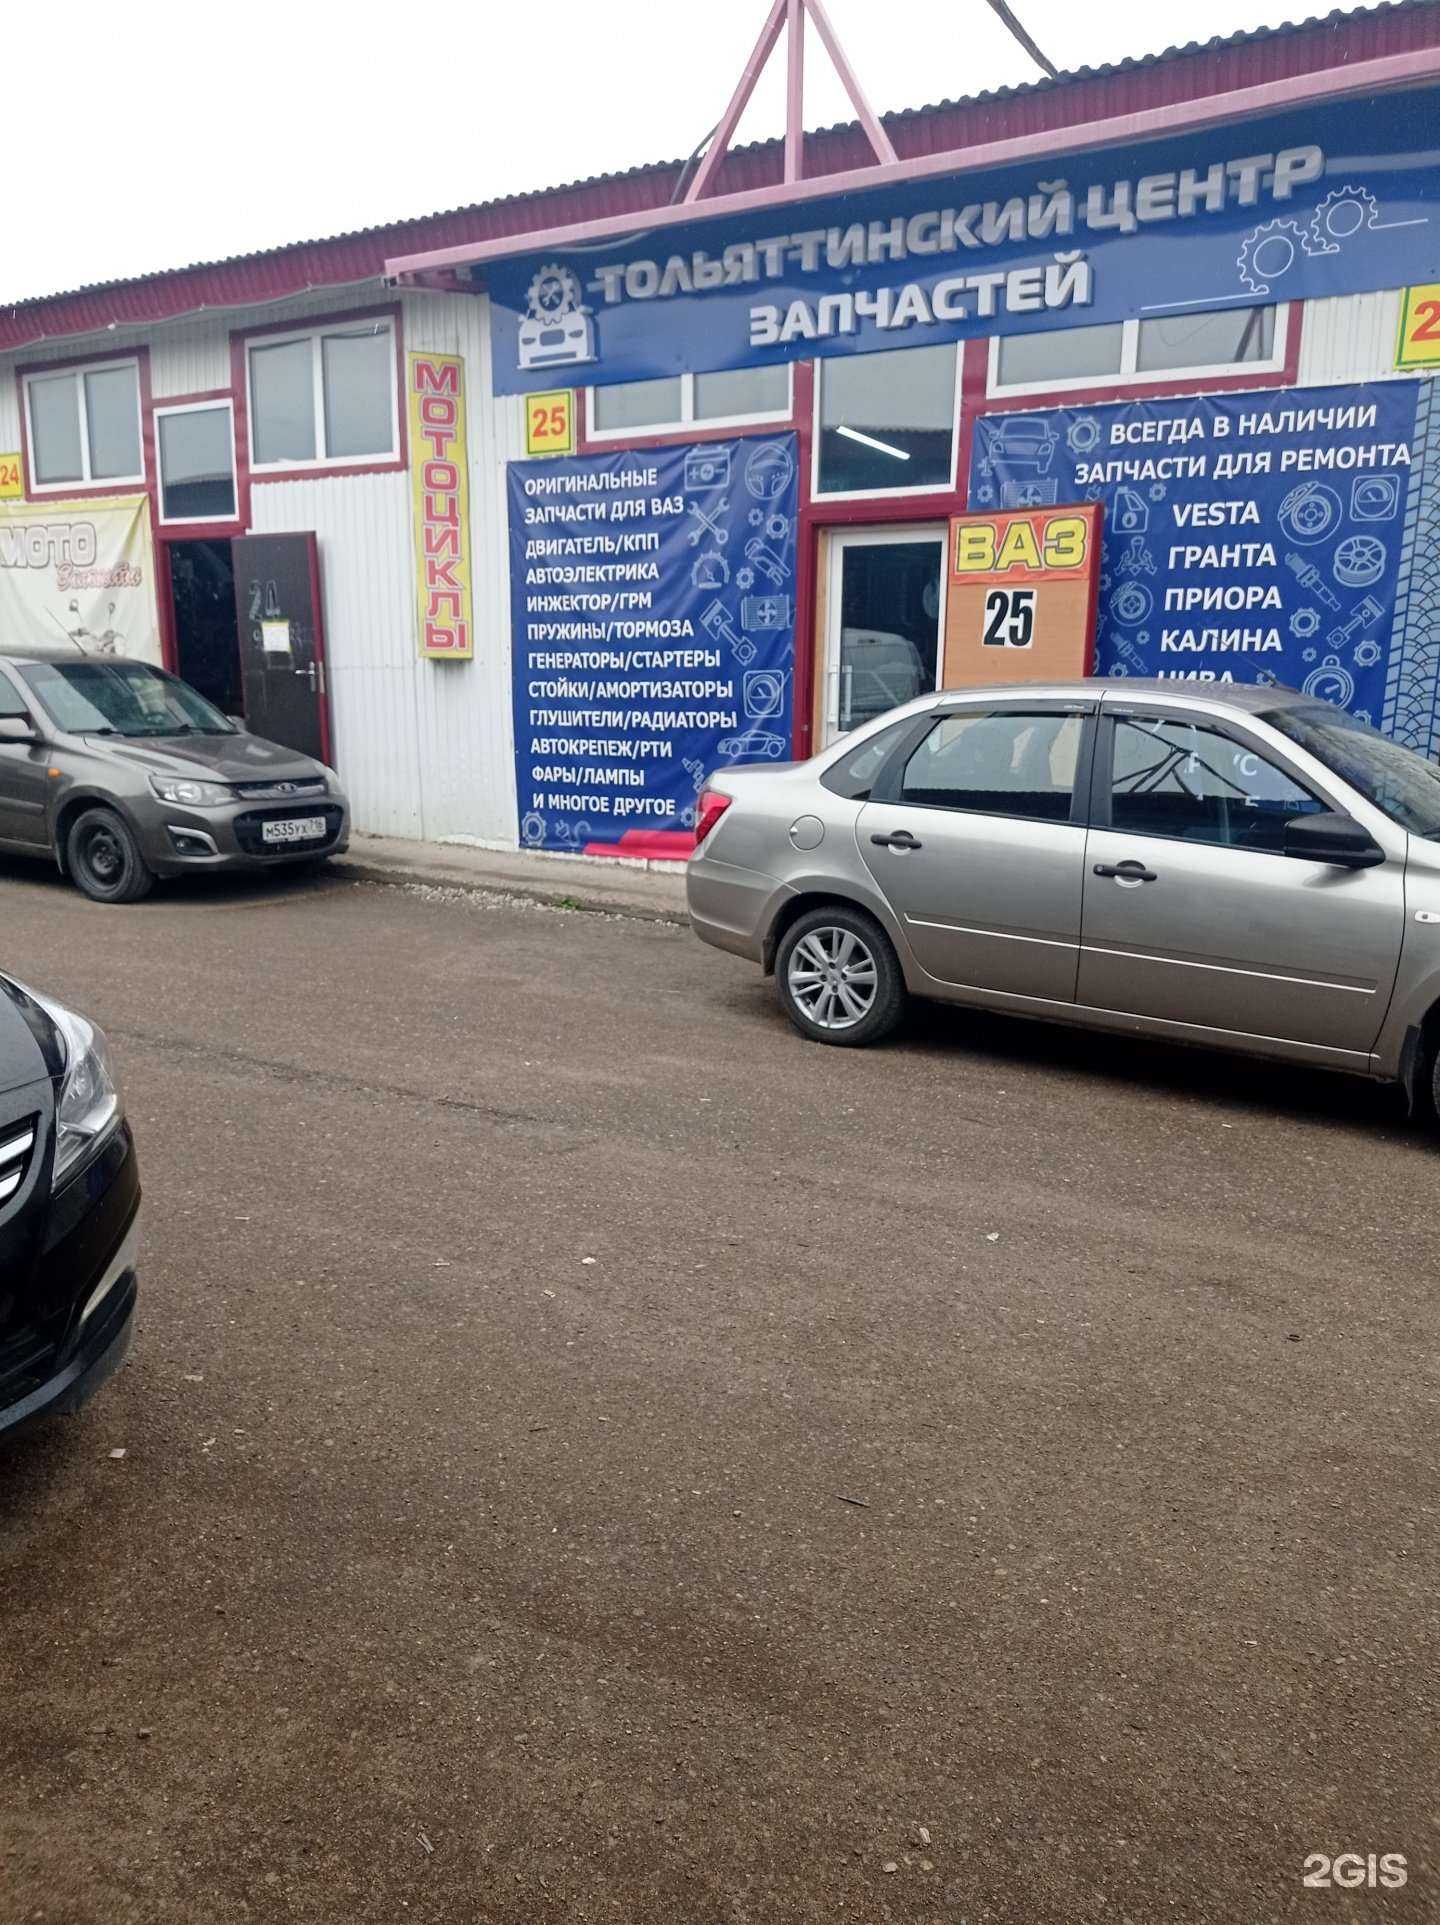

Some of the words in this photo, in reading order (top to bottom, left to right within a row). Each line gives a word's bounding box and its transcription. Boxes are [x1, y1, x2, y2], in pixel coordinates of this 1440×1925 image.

[595, 178, 1074, 302] ТОЛЬЯТТИНСКИЙ
[1086, 145, 1324, 233] ЦЕНТР
[750, 249, 1093, 347] ЗАПЧАСТЕЙ
[532, 405, 566, 438] 25
[1110, 417, 1205, 445] ВСЕГДА
[1213, 416, 1230, 438] В
[1238, 404, 1377, 436] НАЛИЧИИ
[0, 463, 19, 486] 24
[1074, 455, 1206, 484] ЗАПЧАСТИ
[1213, 451, 1271, 480] ДЛЯ
[1280, 443, 1411, 472] РЕМОНТА
[524, 468, 657, 496] ОРИГИНАЛЬНЫЕ
[414, 360, 469, 650] МОТОЦИКЛЫ
[524, 502, 606, 524] ЗАПЧАСТИ
[610, 499, 646, 522] ДЛЯ
[651, 495, 684, 515] ВАЗ
[1172, 501, 1260, 527] VESTA
[0, 521, 97, 570] МОТО
[525, 532, 659, 560] ДВИГАТЕЛЬ/КПП
[957, 515, 1087, 573] ВАЗ
[1168, 543, 1277, 569] ГРАНТА
[526, 562, 660, 584] АВТОЭЛЕКТРИКА
[527, 591, 652, 612] ИНЖЕКТОР/ГРМ
[1164, 586, 1282, 611] ПРИОРА
[527, 619, 694, 642] ПРУЖИНЫ/ТОРМОЗА
[983, 591, 1034, 647] 25
[1161, 628, 1282, 652] КАЛИНА
[528, 649, 720, 671] ГЕНЕРАТОРЫ/СТАРТЕРЫ
[528, 677, 733, 701] СТОЙКИ/АМОРТИЗАТОРЫ
[530, 709, 737, 731] ГЛУШИТЕЛИ/РАДИАТОРЫ
[530, 738, 672, 759] АВТОКРЕПЕЖ/РТИ
[532, 766, 644, 786] ФАРЫ/ЛАМПЫ
[533, 793, 544, 809] И
[548, 794, 610, 812] МНОГОЕ
[613, 797, 675, 816] ДРУГОЕ
